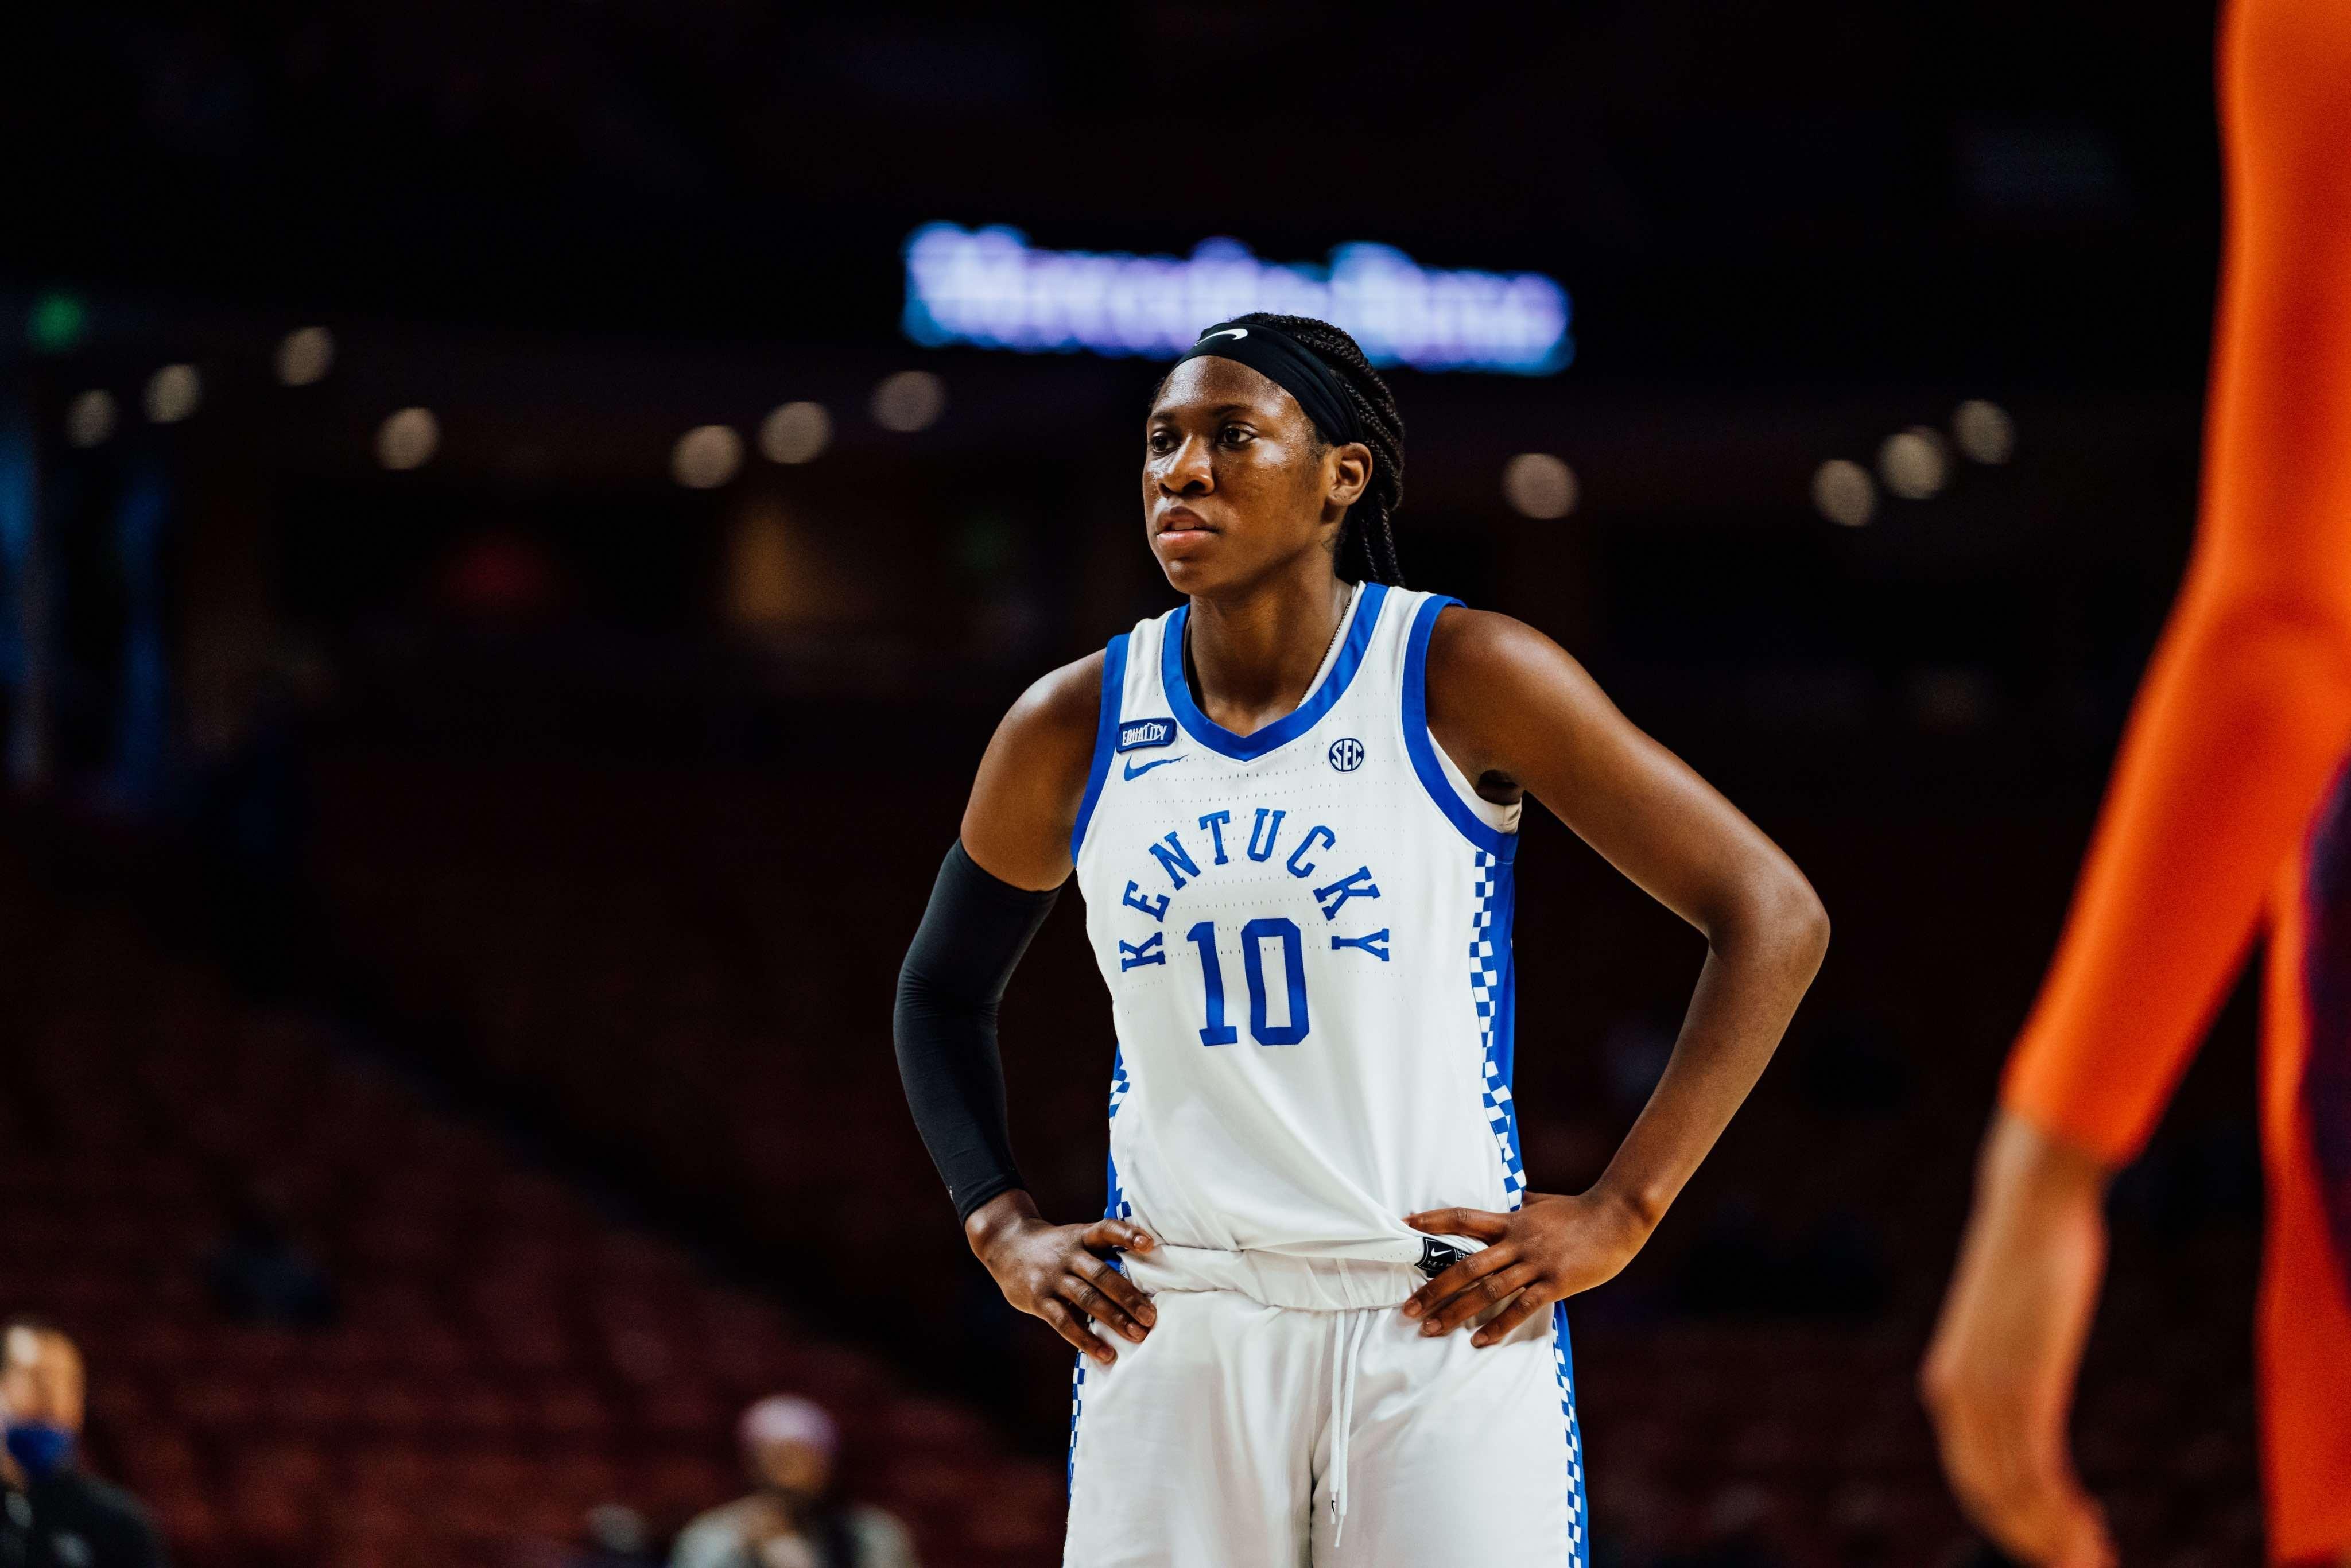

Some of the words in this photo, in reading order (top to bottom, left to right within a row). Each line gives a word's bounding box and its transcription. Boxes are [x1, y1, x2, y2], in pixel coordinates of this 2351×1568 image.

[1122, 723, 1167, 746] EQUALITY
[1331, 739, 1363, 770] SEC
[1119, 808, 1390, 972] KENTUCKY
[1186, 918, 1310, 1046] 10
